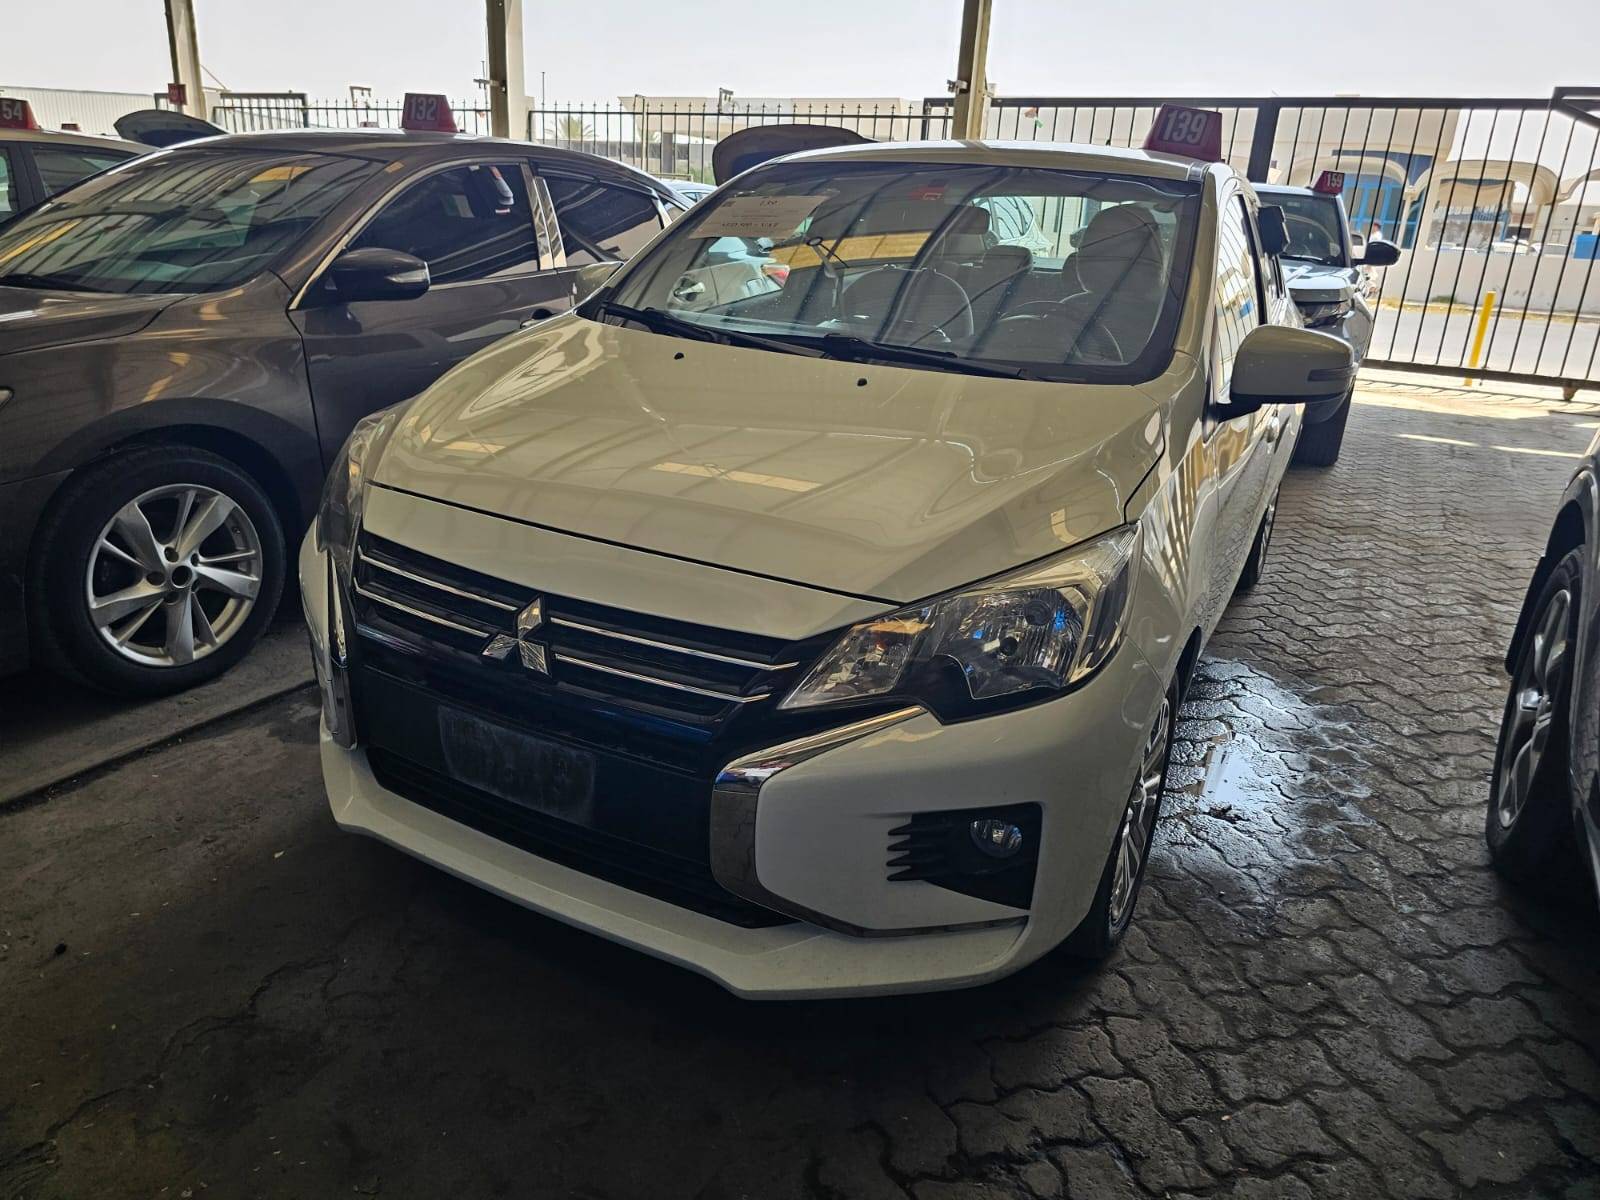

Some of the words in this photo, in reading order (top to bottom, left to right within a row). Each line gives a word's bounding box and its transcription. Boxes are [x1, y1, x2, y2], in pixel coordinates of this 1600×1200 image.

[410, 96, 437, 120] 132
[1163, 110, 1207, 144] 139
[1327, 172, 1343, 188] 159
